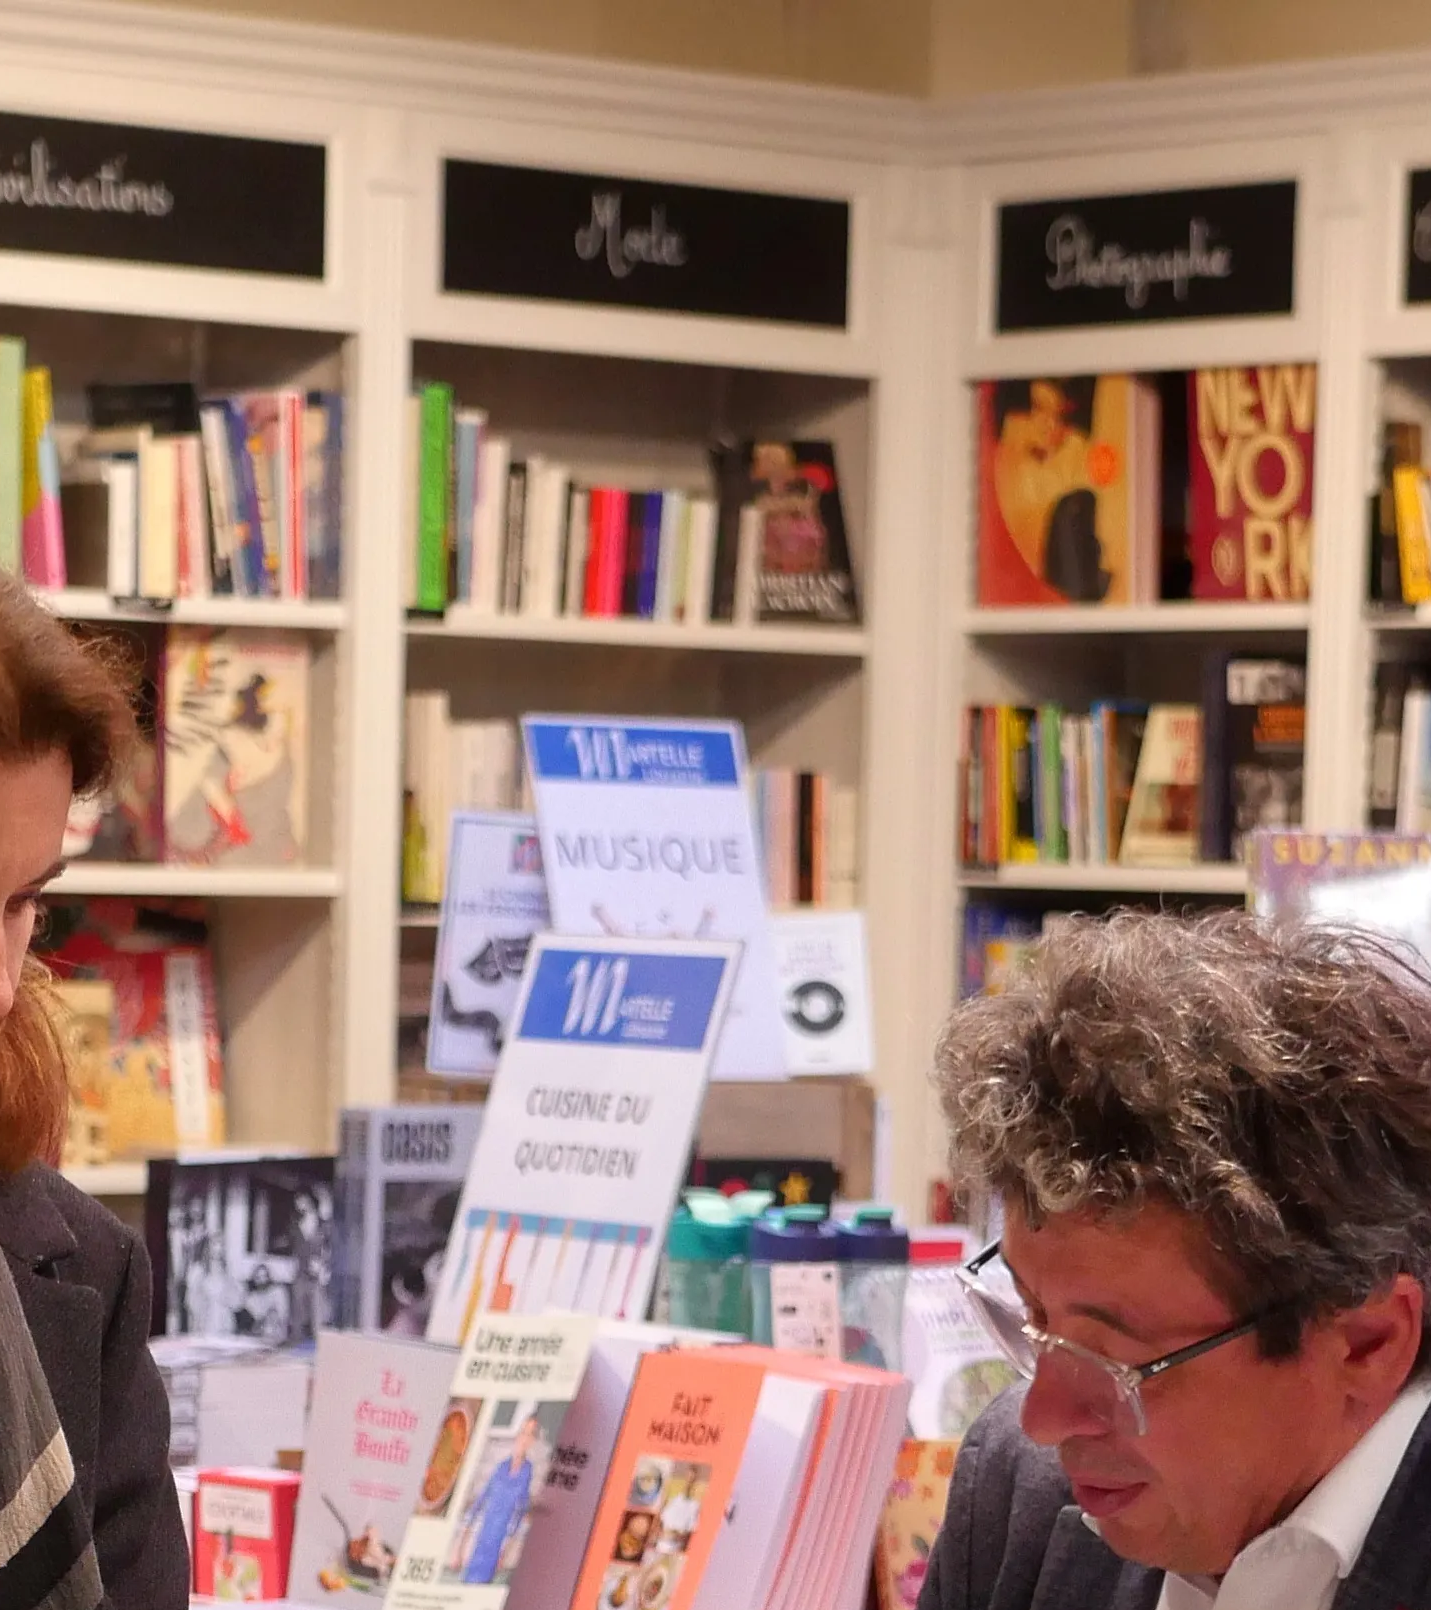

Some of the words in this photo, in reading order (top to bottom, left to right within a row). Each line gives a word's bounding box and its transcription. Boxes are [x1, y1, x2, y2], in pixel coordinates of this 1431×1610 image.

[575, 190, 689, 277] Mode
[1195, 364, 1316, 437] NEW
[553, 832, 747, 881] MUSIQUE
[526, 1085, 612, 1122] CUISINE
[615, 1094, 653, 1125] DU
[381, 1121, 455, 1166] OASIS
[514, 1141, 642, 1180] QUOTIDIEN
[475, 1328, 511, 1355] Une
